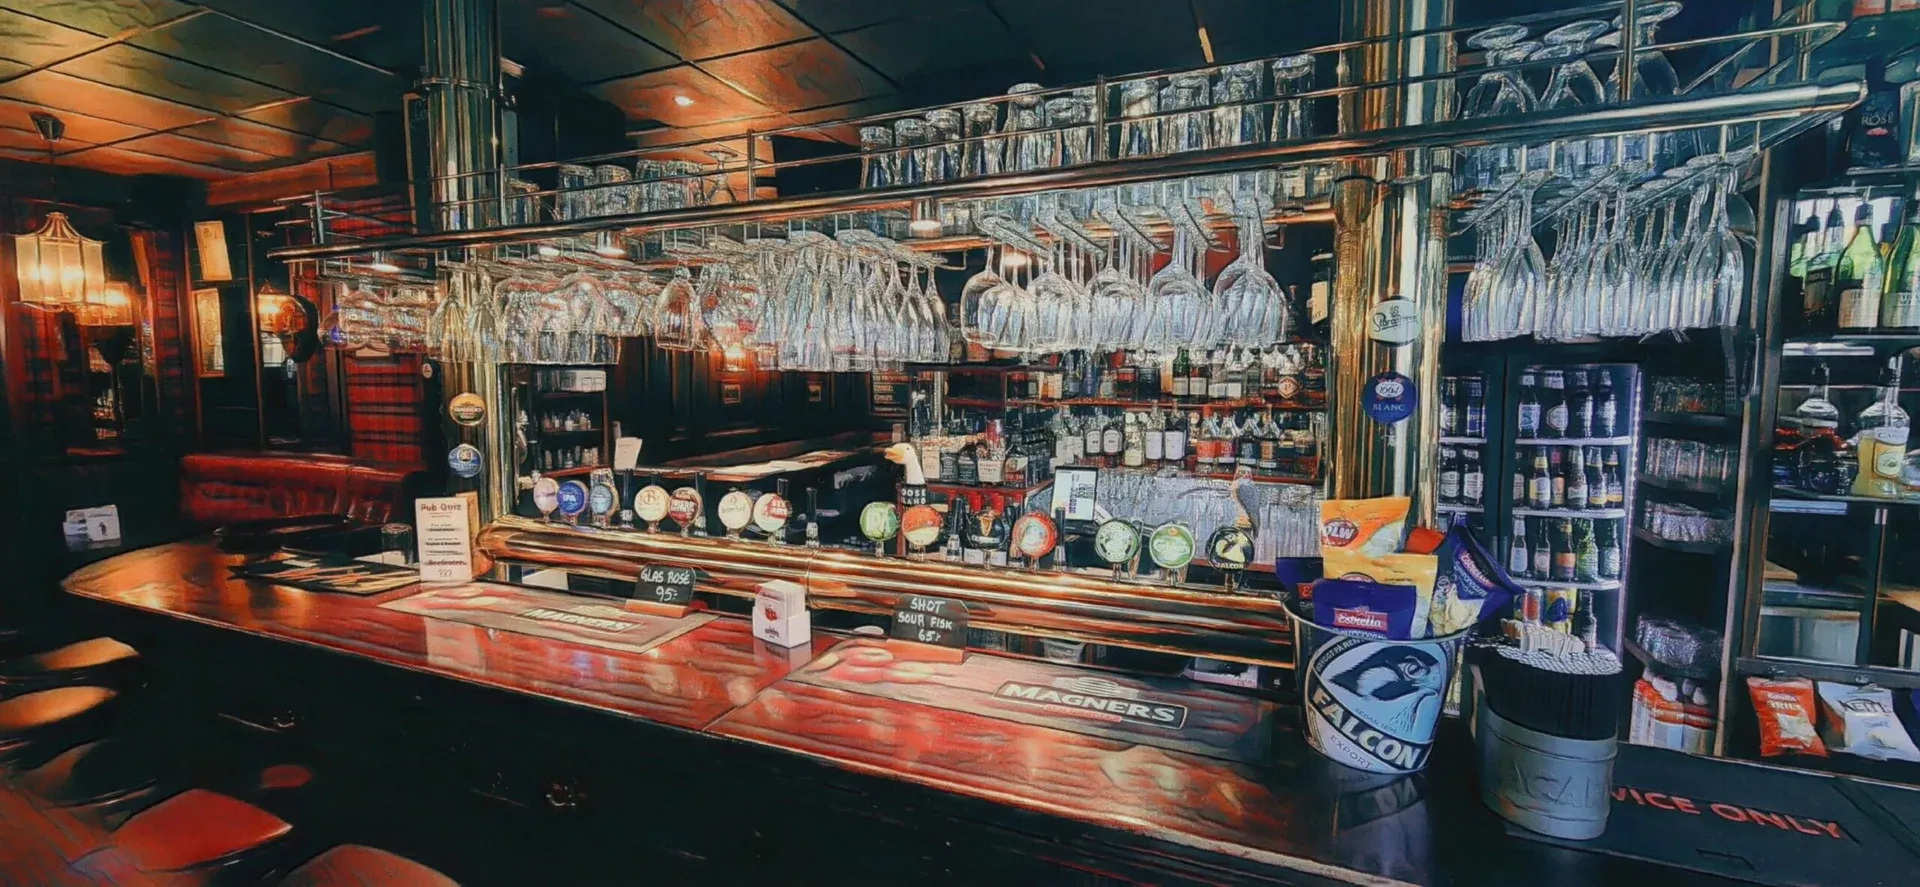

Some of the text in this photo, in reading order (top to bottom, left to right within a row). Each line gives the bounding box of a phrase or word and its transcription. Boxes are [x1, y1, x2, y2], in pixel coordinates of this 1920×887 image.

[1372, 403, 1405, 412] BLANC
[901, 488, 926, 497] OOSE
[901, 497, 926, 505] LAND
[420, 503, 462, 511] Pub Quiz
[640, 568, 690, 585] GLAS ROSÉ
[910, 597, 946, 614] SHOT
[897, 611, 953, 630] SOUR FISK
[1337, 612, 1382, 628] Estrella
[1003, 684, 1176, 722] MAGNERS
[1312, 687, 1421, 769] FALCON
[1330, 734, 1373, 769] EXPORT
[1611, 787, 1841, 839] VICE ONLY
